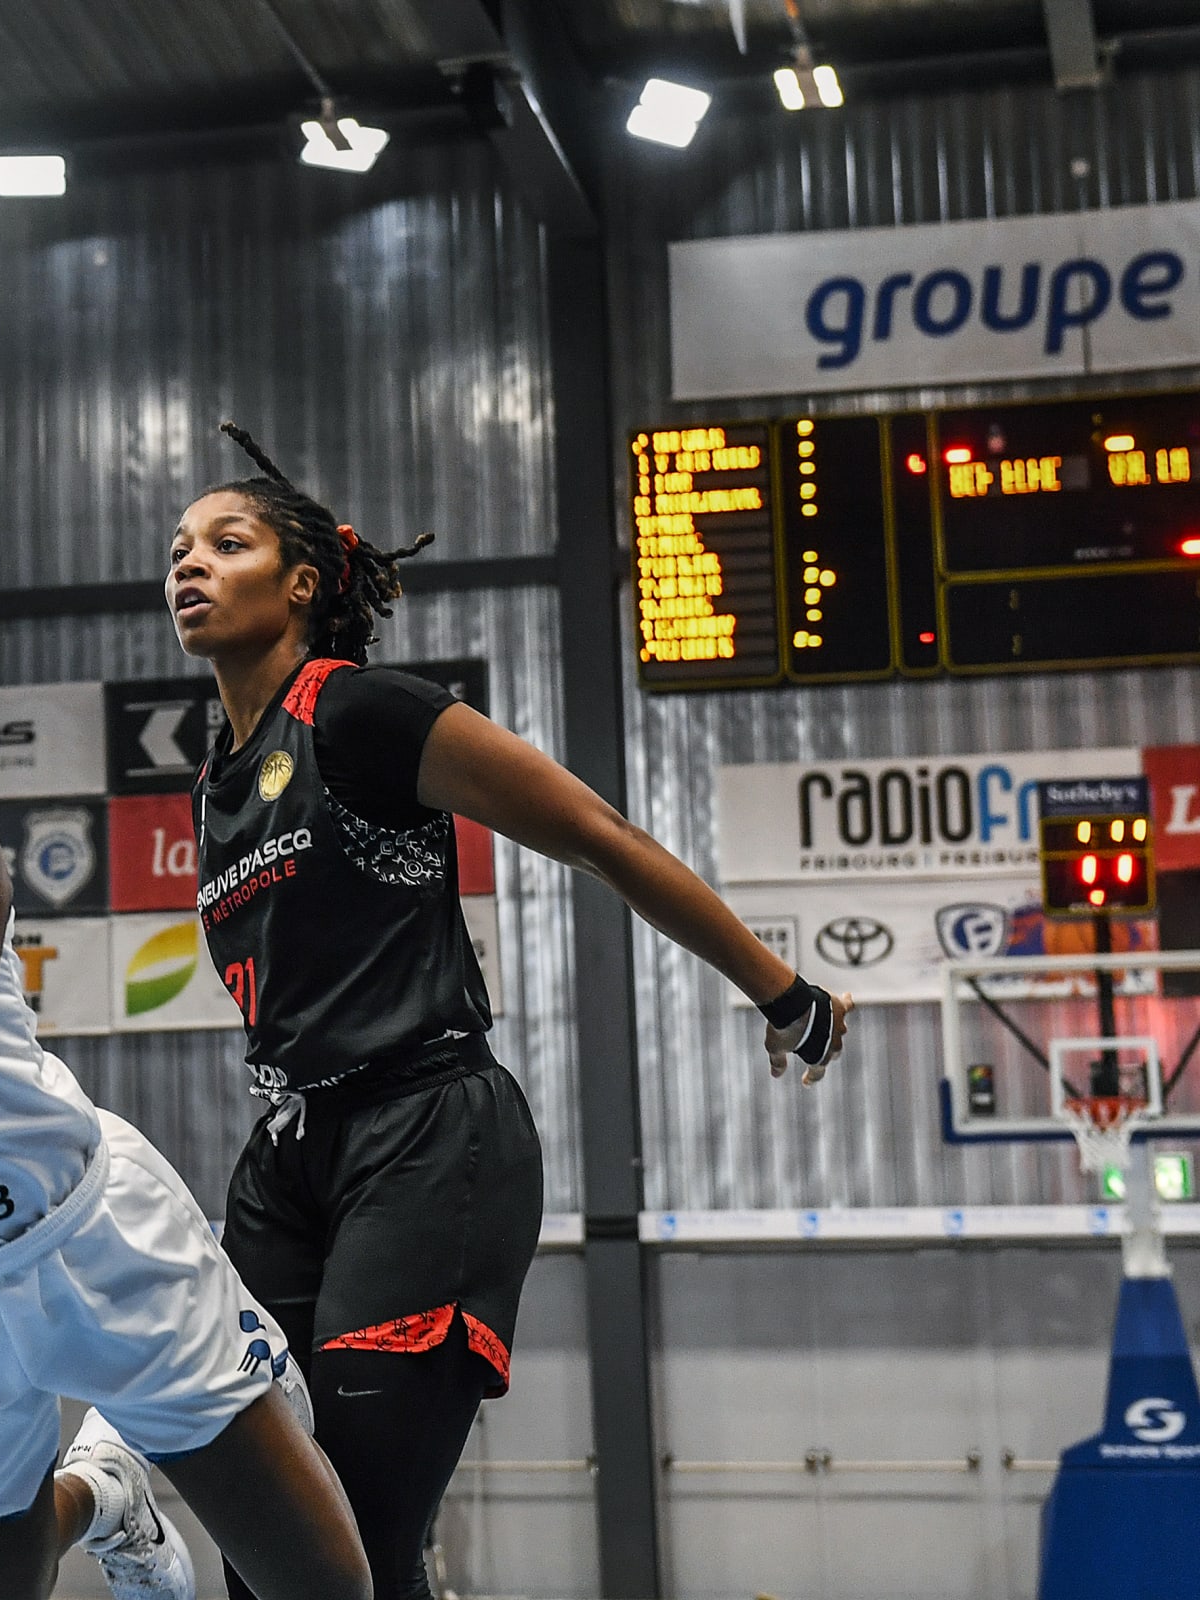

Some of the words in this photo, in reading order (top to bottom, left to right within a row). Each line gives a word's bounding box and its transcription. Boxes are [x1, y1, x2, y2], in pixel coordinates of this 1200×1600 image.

[805, 249, 1186, 371] groupe
[151, 827, 197, 878] la
[196, 864, 239, 914] NEUVE
[238, 827, 313, 881] D'ASCQ
[800, 852, 917, 872] FRIBOURG
[939, 849, 1039, 868] FREIBUR
